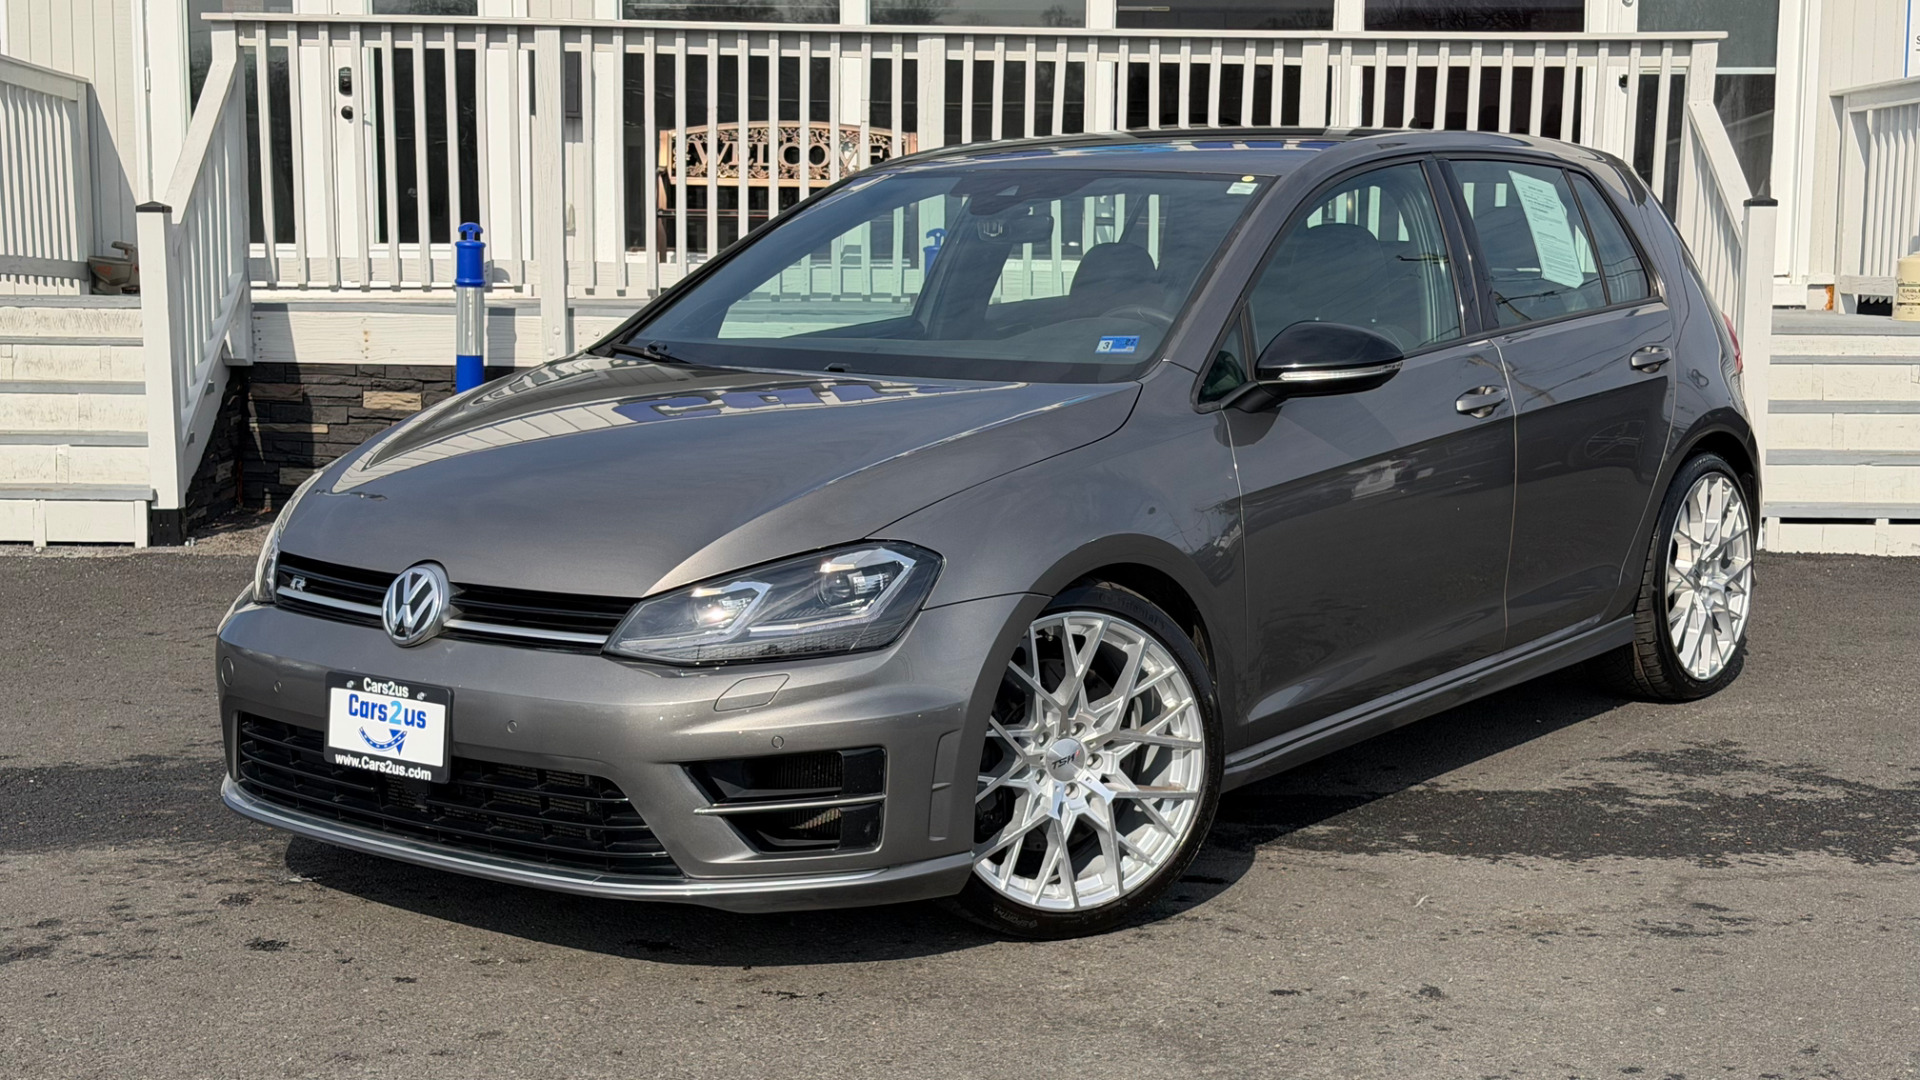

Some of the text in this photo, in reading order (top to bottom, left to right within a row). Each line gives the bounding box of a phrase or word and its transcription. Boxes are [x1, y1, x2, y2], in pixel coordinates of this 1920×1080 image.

[1103, 342, 1110, 350] 3
[291, 575, 307, 592] R
[363, 677, 410, 698] Cars2us
[348, 693, 427, 729] Cars2us
[335, 753, 432, 781] www.Cars2us.com
